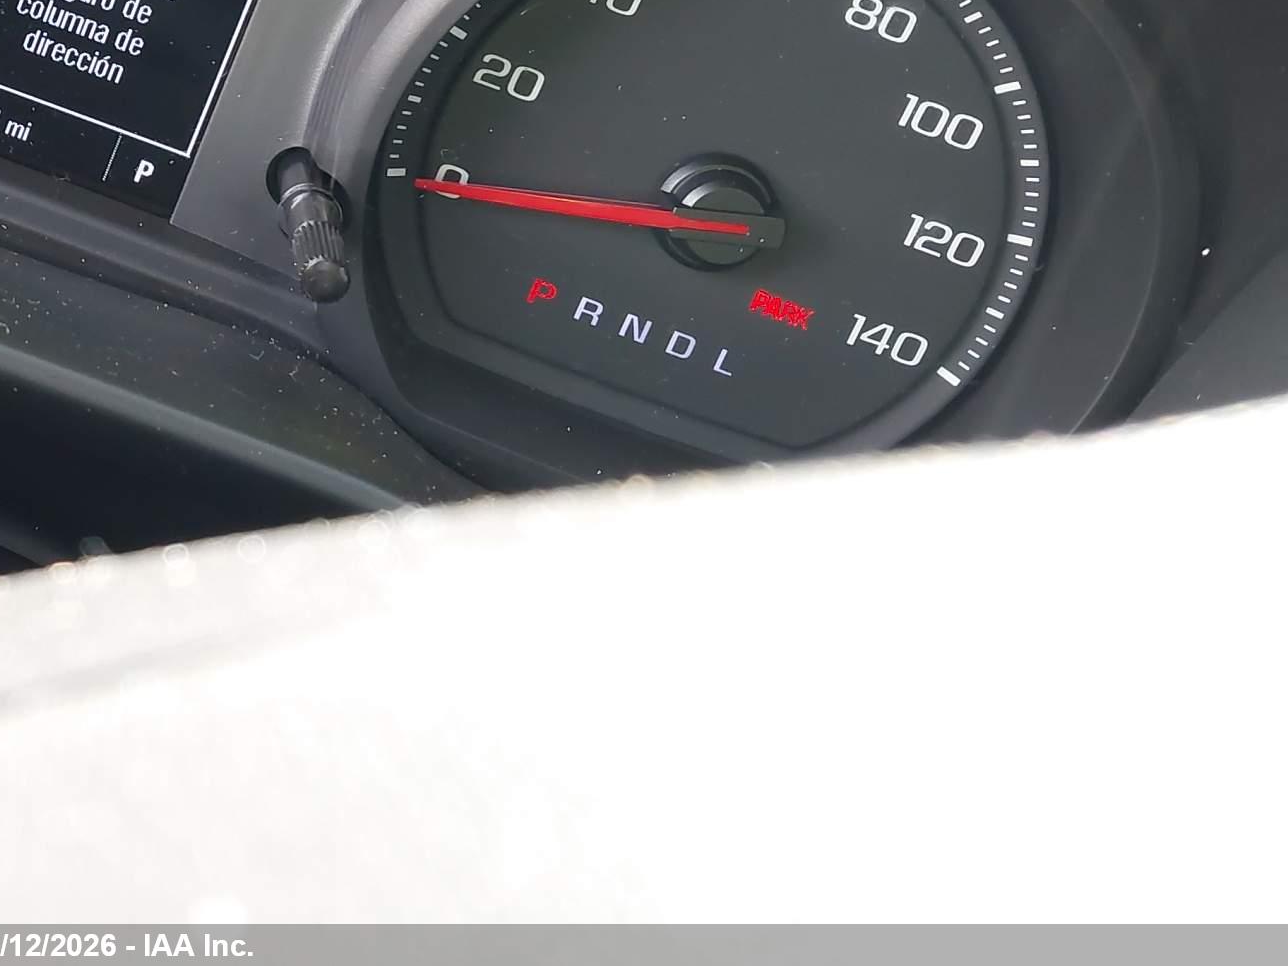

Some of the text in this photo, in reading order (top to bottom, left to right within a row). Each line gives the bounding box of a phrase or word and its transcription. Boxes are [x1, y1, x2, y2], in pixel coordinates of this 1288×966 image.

[23, 30, 124, 84] dirección
[114, 29, 144, 55] de
[473, 53, 545, 102] 20
[5, 114, 32, 142] mi
[897, 93, 983, 150] 100
[134, 160, 154, 182] P
[903, 214, 984, 268] 120
[526, 279, 733, 376] P R N D L
[750, 288, 815, 330] PARK
[846, 314, 928, 367] 140
